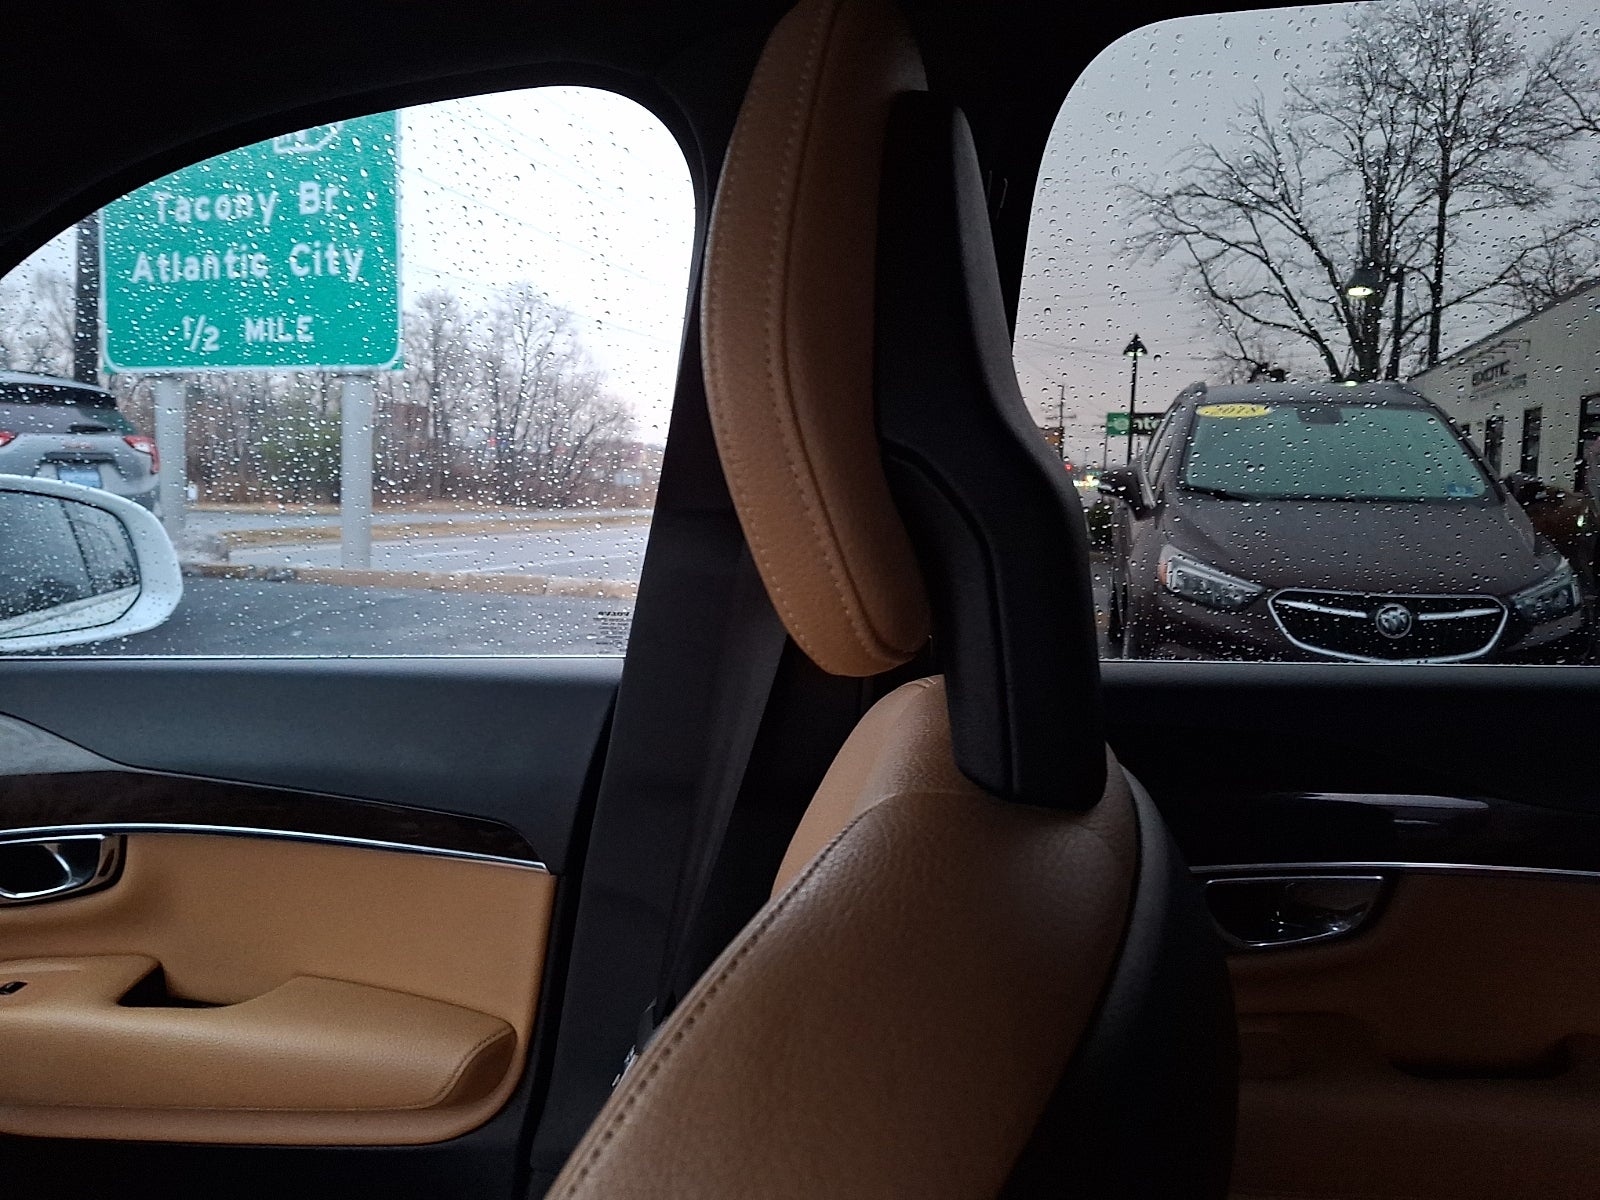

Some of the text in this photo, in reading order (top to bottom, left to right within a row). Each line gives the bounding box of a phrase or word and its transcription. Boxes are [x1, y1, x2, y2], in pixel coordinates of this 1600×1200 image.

[152, 181, 339, 227] Tacony Br
[131, 241, 365, 283] Atlantic City
[182, 315, 315, 351] 1/2 MILE
